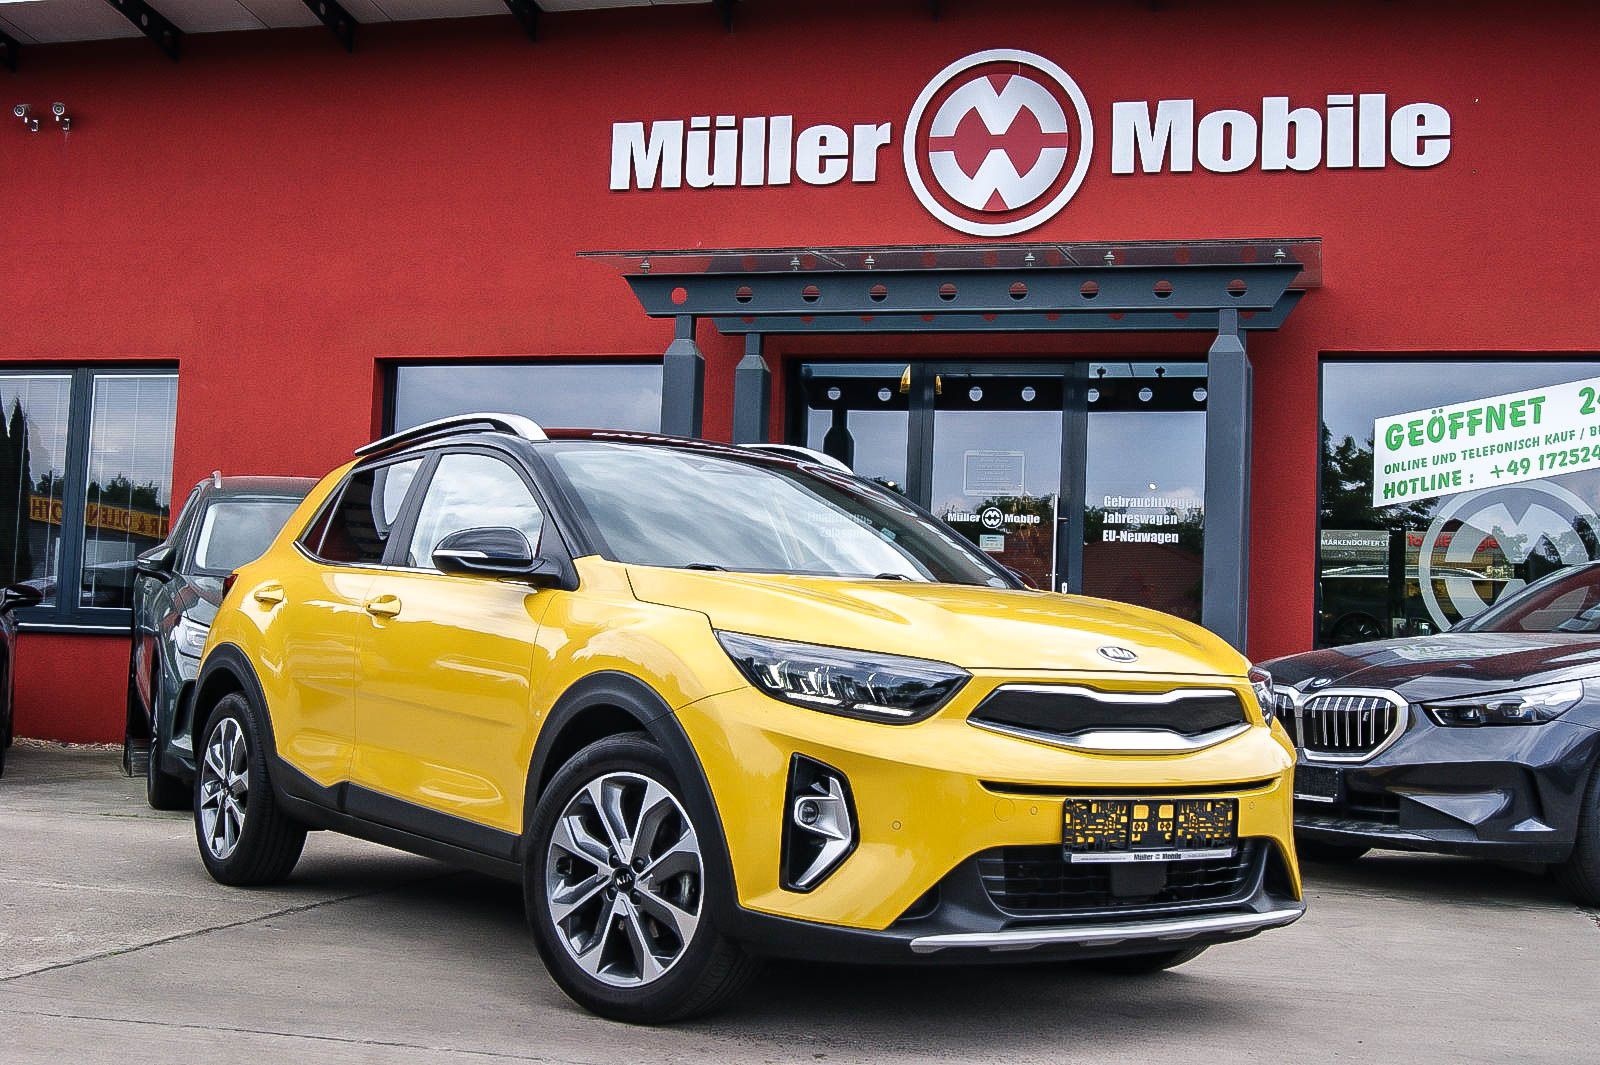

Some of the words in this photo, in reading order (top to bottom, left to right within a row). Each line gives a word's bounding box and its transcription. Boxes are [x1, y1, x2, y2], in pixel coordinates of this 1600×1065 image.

[609, 115, 892, 190] Müller
[1112, 93, 1450, 174] Mobile
[1385, 396, 1546, 451] GEÖFFNET
[1384, 457, 1427, 475] ONLINE
[1432, 453, 1457, 466] UND
[1461, 436, 1540, 460] TELEFONISCH
[1544, 429, 1576, 445] KAUF
[1383, 470, 1462, 500] HOTLINE
[1490, 457, 1531, 479] +49
[1103, 495, 1202, 510] Gebrauchtwagen
[947, 512, 981, 522] Müller
[1004, 513, 1041, 524] Mobile
[1103, 511, 1178, 526] Jahreswagen
[1102, 529, 1179, 545] EU-Neuwagen
